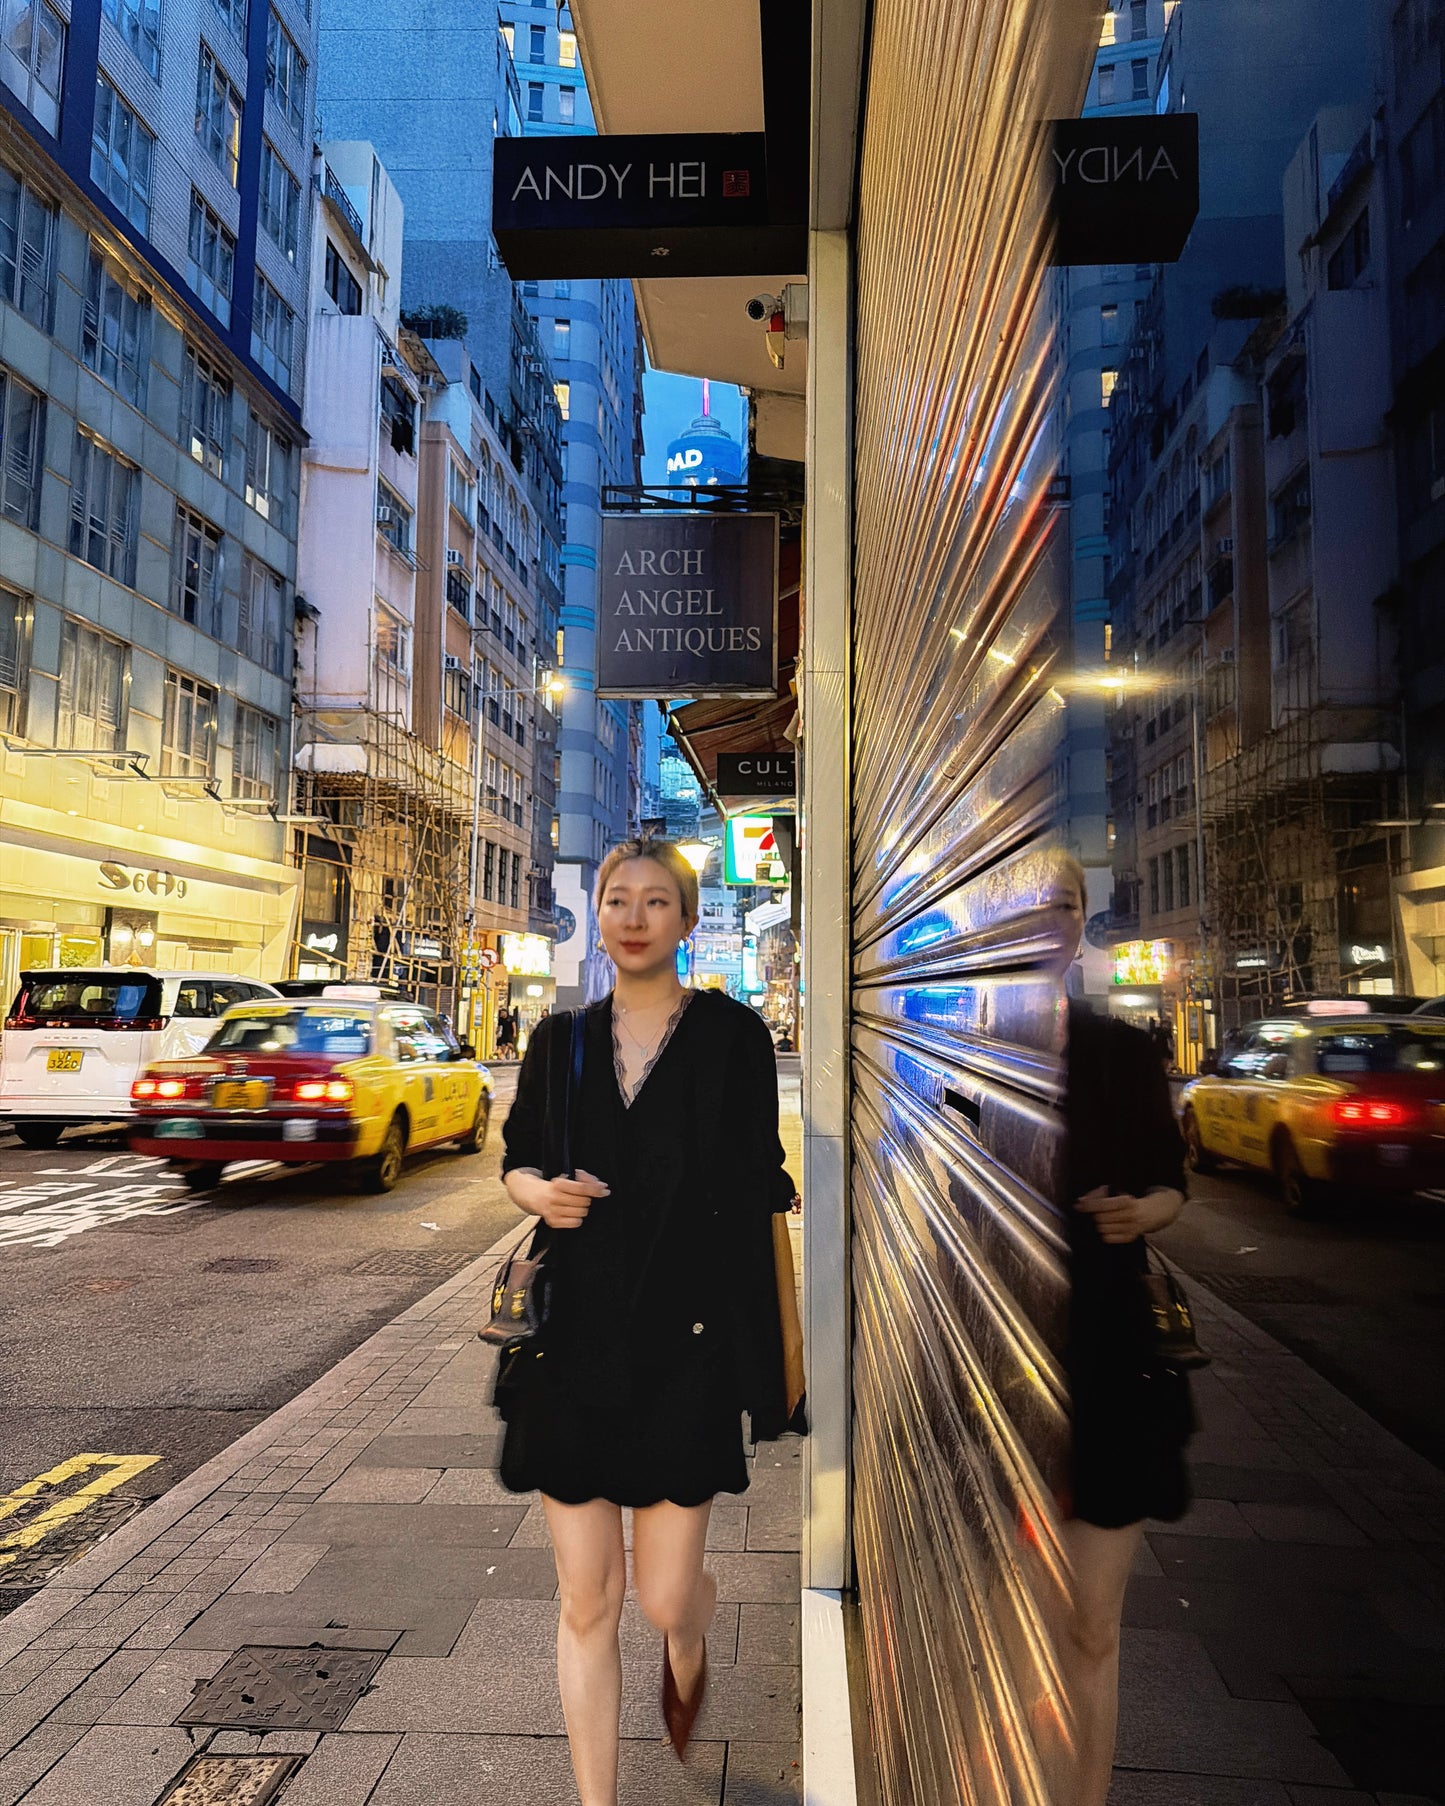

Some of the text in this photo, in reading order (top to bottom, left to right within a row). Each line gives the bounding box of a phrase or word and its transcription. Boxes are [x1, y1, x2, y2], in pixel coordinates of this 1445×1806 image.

[511, 164, 632, 201] ANDY
[649, 162, 706, 198] HEI
[614, 549, 705, 576] ARCH
[613, 589, 723, 616] ANGEL
[613, 627, 761, 657] ANTIQUES
